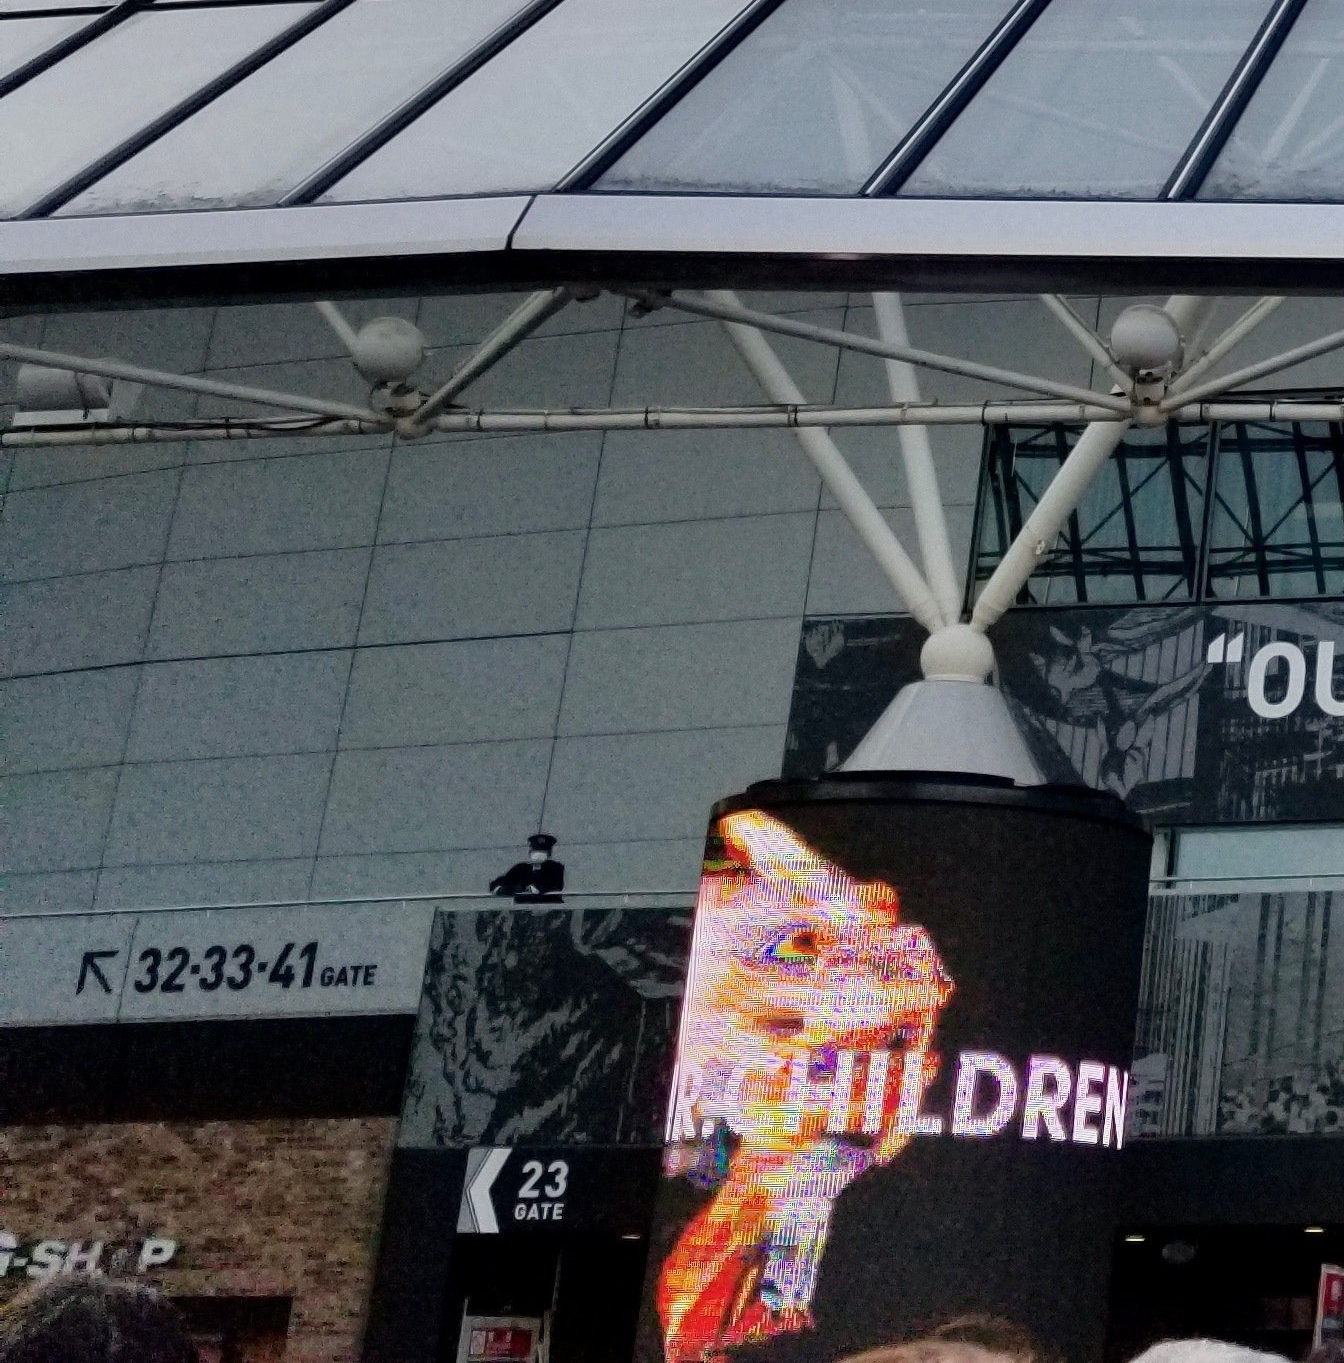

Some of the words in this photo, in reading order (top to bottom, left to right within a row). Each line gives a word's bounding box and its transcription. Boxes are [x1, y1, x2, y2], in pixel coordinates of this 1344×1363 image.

[320, 963, 377, 987] GATE
[518, 1160, 569, 1199] 23
[514, 1203, 564, 1221] GATE
[0, 1230, 178, 1278] -SHP
